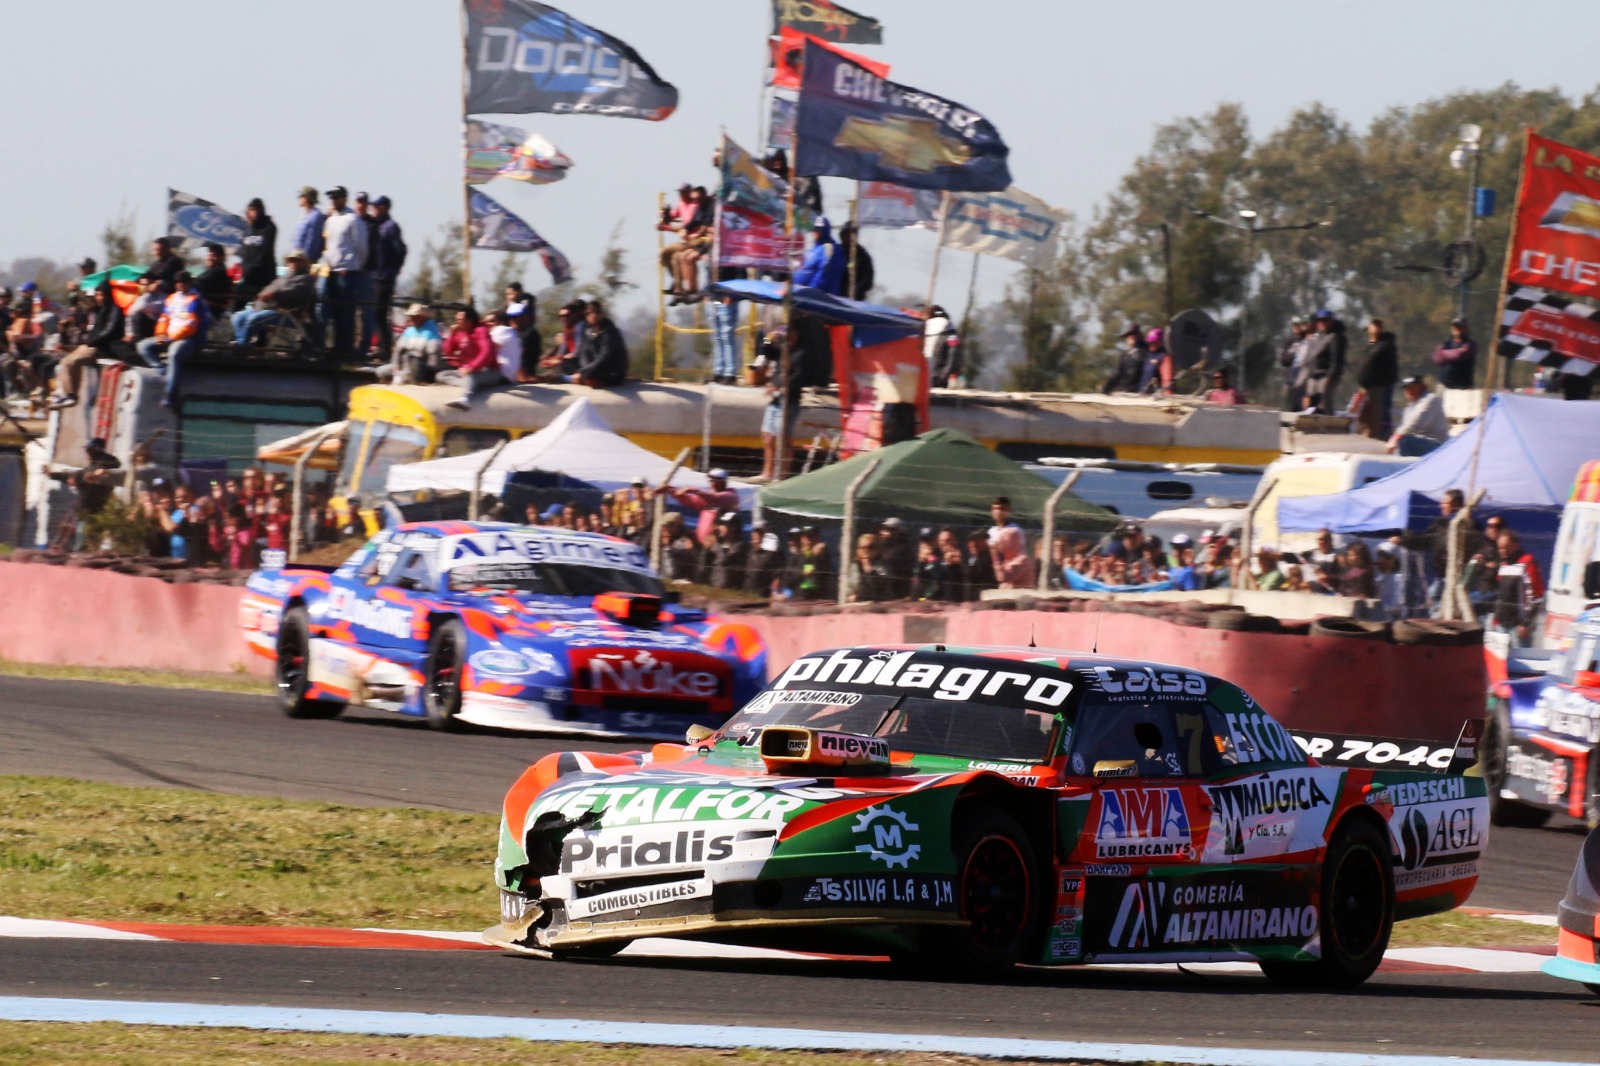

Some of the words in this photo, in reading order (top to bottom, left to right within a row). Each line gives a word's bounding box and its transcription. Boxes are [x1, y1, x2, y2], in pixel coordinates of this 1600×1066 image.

[773, 650, 1073, 706] philagro
[783, 691, 860, 705] ALTAMIRANO
[1175, 712, 1204, 775] 7
[967, 760, 1032, 773] LOBERIA
[1387, 777, 1466, 805] TEDESCHI
[1097, 787, 1191, 840] AMA
[874, 824, 902, 848] M
[1428, 807, 1479, 852] AGL
[561, 829, 734, 874] Prialis
[1098, 842, 1191, 858] LUBRICANTS
[588, 882, 696, 913] COMBUSTIBLES
[843, 878, 886, 902] SILVA
[921, 883, 929, 899] &
[1065, 881, 1082, 891] YPF
[1173, 880, 1244, 906] GOMERÍA
[1163, 904, 1318, 943] ALTAMIRANO
